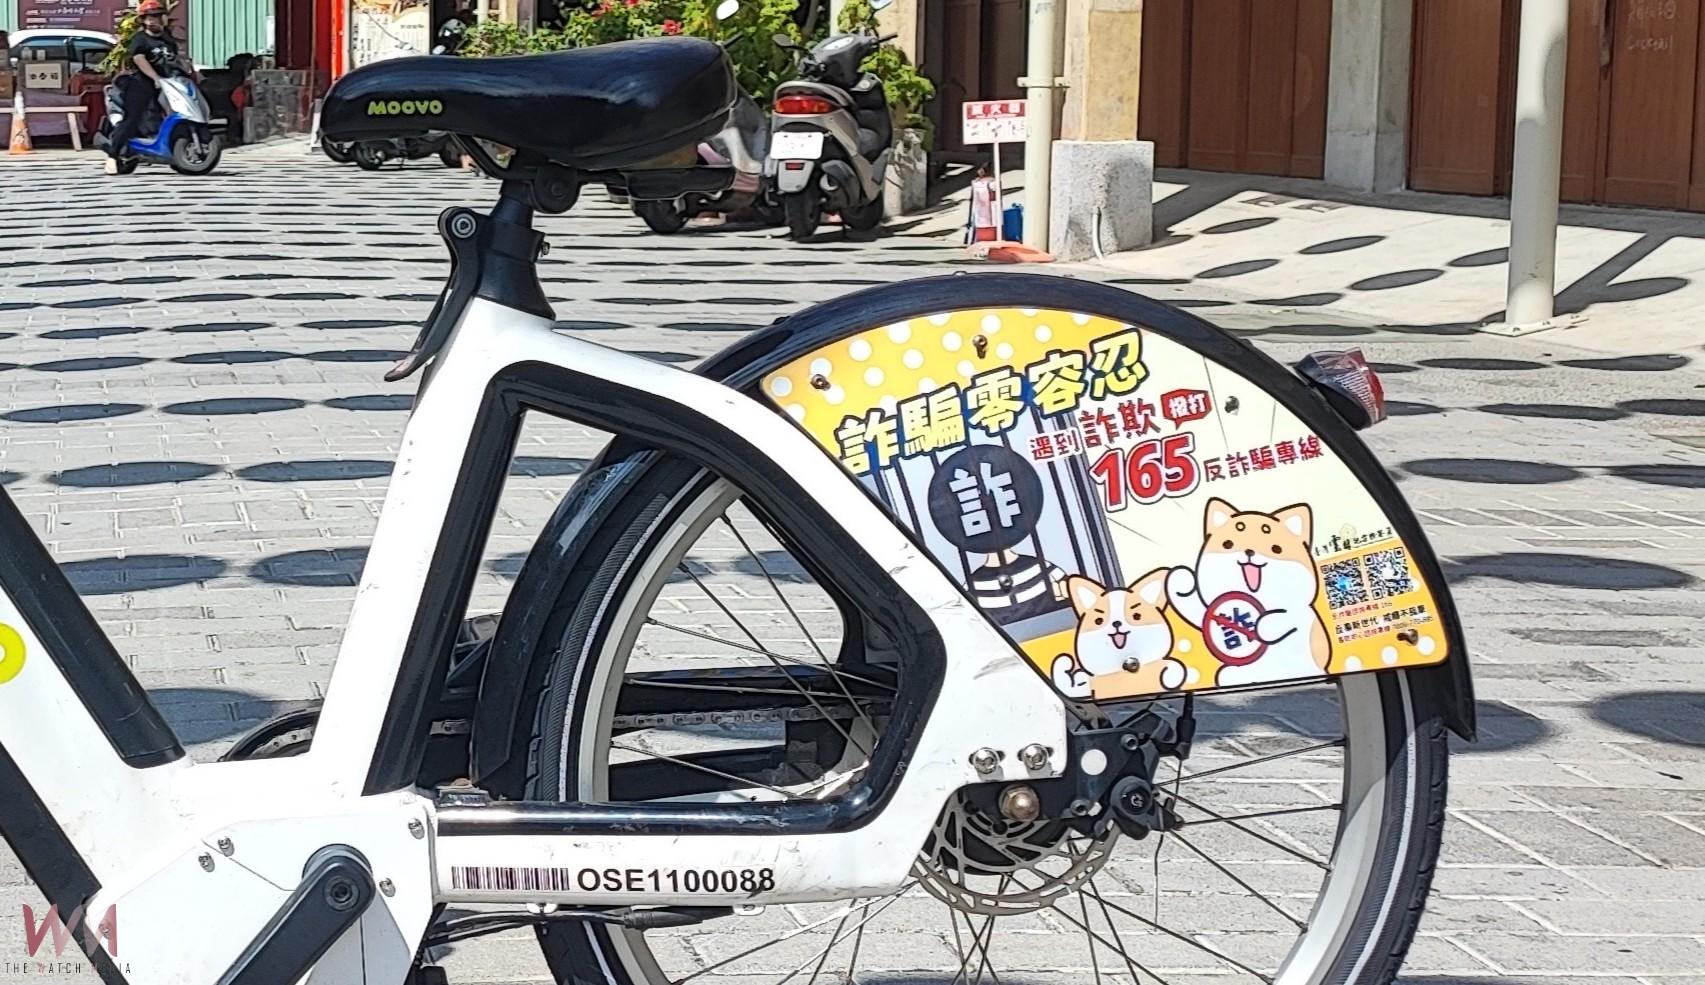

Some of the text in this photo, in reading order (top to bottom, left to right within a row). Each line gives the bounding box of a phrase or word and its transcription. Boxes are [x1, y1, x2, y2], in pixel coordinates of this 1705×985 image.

[367, 100, 443, 115] MOOVO
[833, 328, 1150, 474] 詐騙零容忍
[1090, 433, 1194, 511] 165
[1203, 435, 1325, 482] 反詐騙專線
[948, 462, 1022, 538] 詐
[577, 868, 776, 893] OSE1100088
